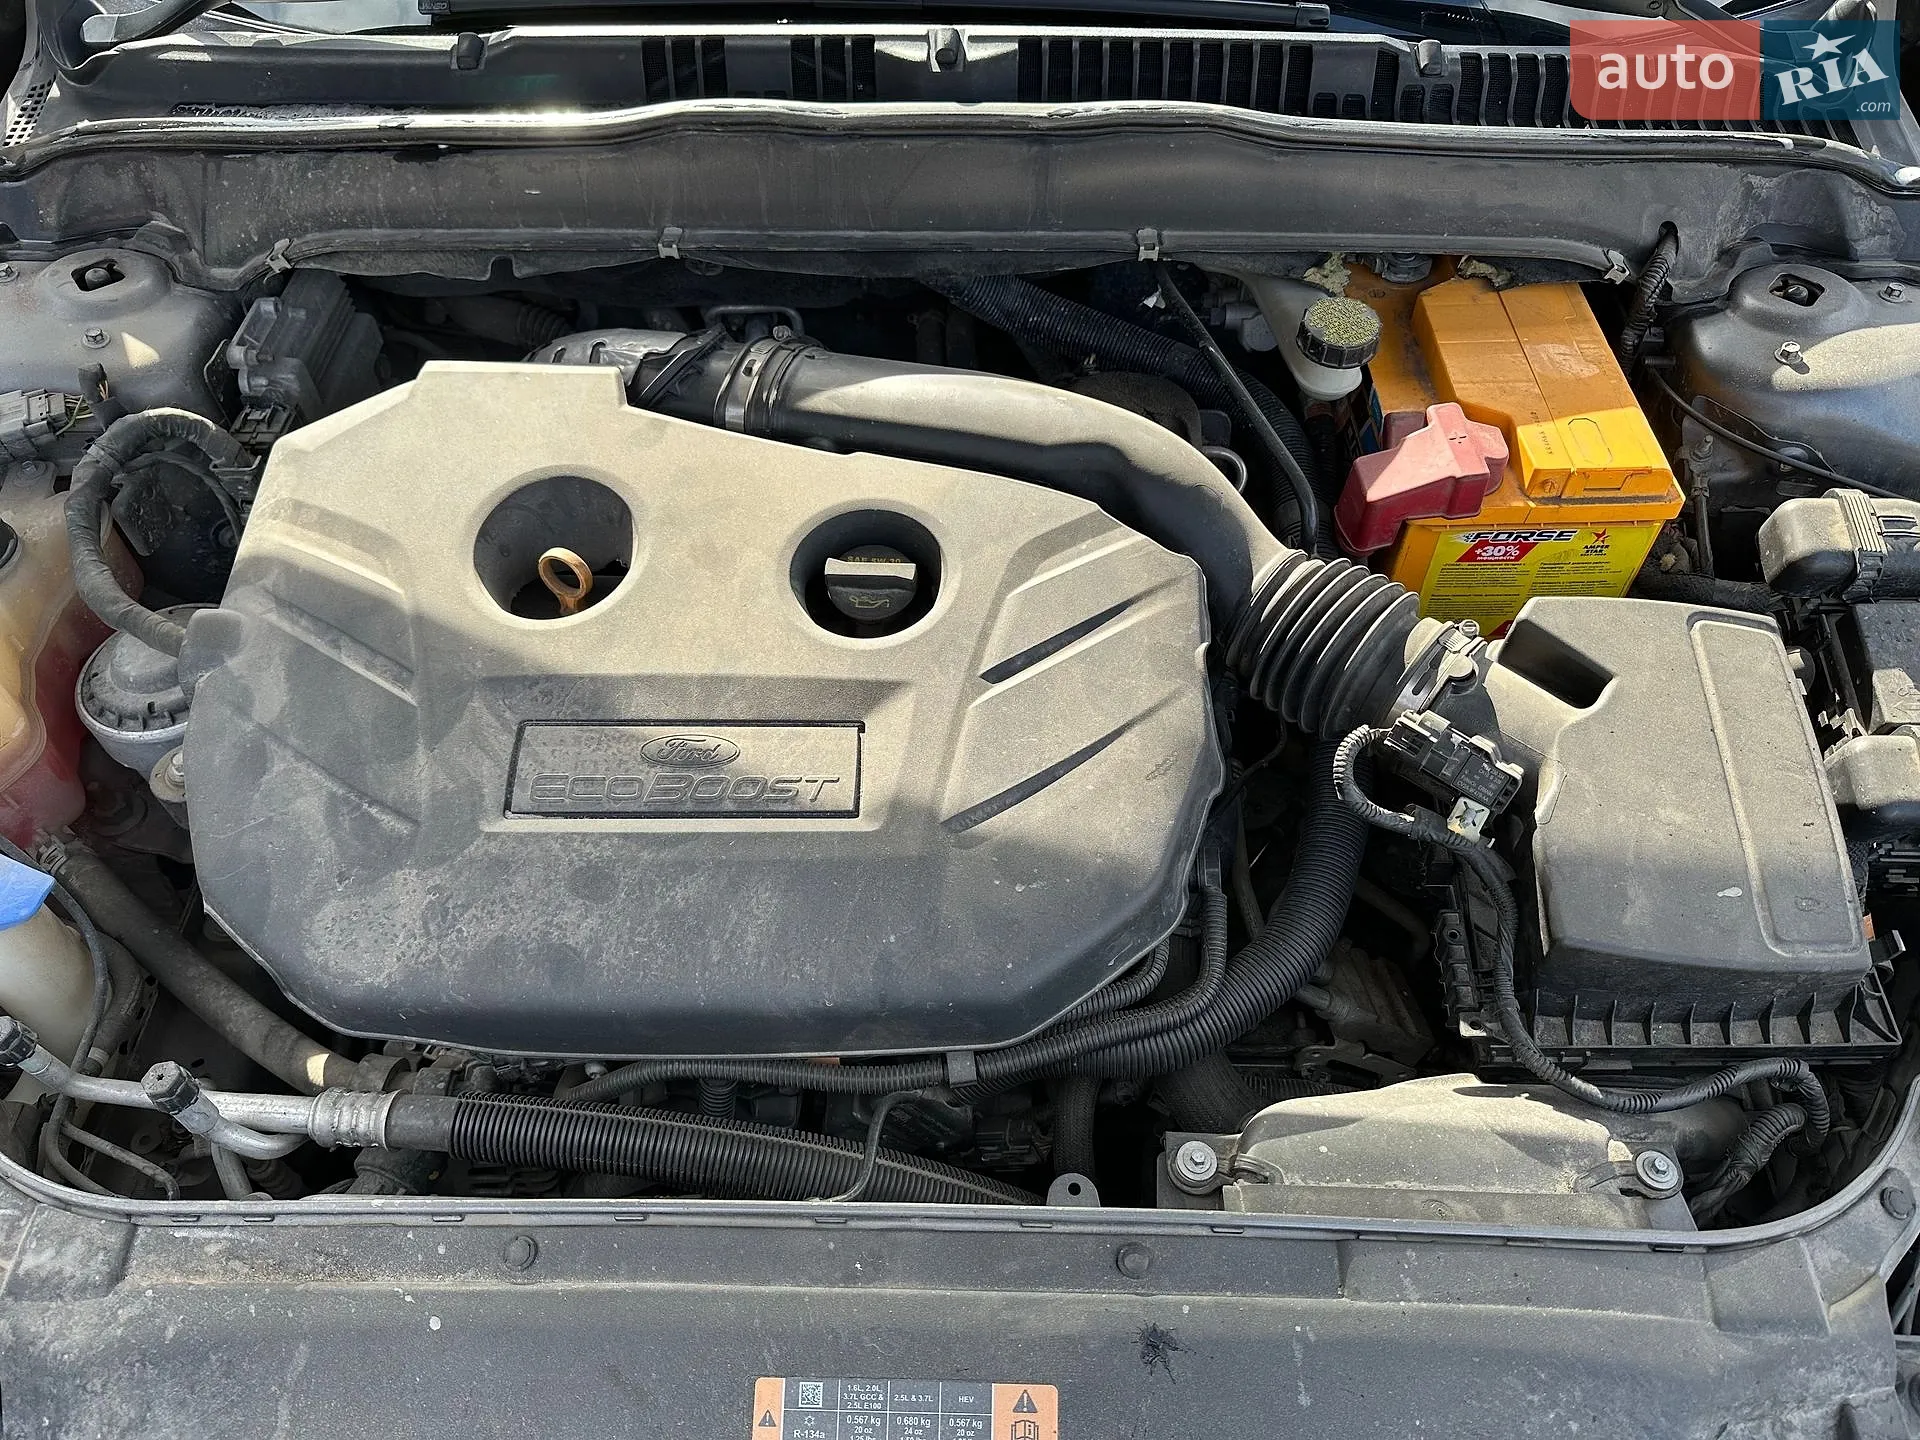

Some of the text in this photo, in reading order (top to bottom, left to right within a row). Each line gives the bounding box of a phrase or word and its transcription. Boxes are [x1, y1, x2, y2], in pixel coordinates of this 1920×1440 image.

[1471, 530, 1579, 543] FORSE
[1475, 545, 1520, 557] +30%
[657, 737, 722, 761] Ford
[530, 773, 839, 804] ECOBOOST
[847, 1384, 864, 1392] 1.6L,
[918, 1394, 933, 1402] 3.7L
[958, 1395, 974, 1403] HEV
[847, 1401, 863, 1409] 2.5L
[846, 1414, 881, 1427] 0.567 kg
[896, 1416, 931, 1428] 0.680 kg
[949, 1418, 982, 1429] 0.567 kg
[794, 1429, 825, 1439] R-134a
[854, 1425, 863, 1434] 20
[904, 1427, 913, 1435] 24
[956, 1428, 965, 1436] 20
